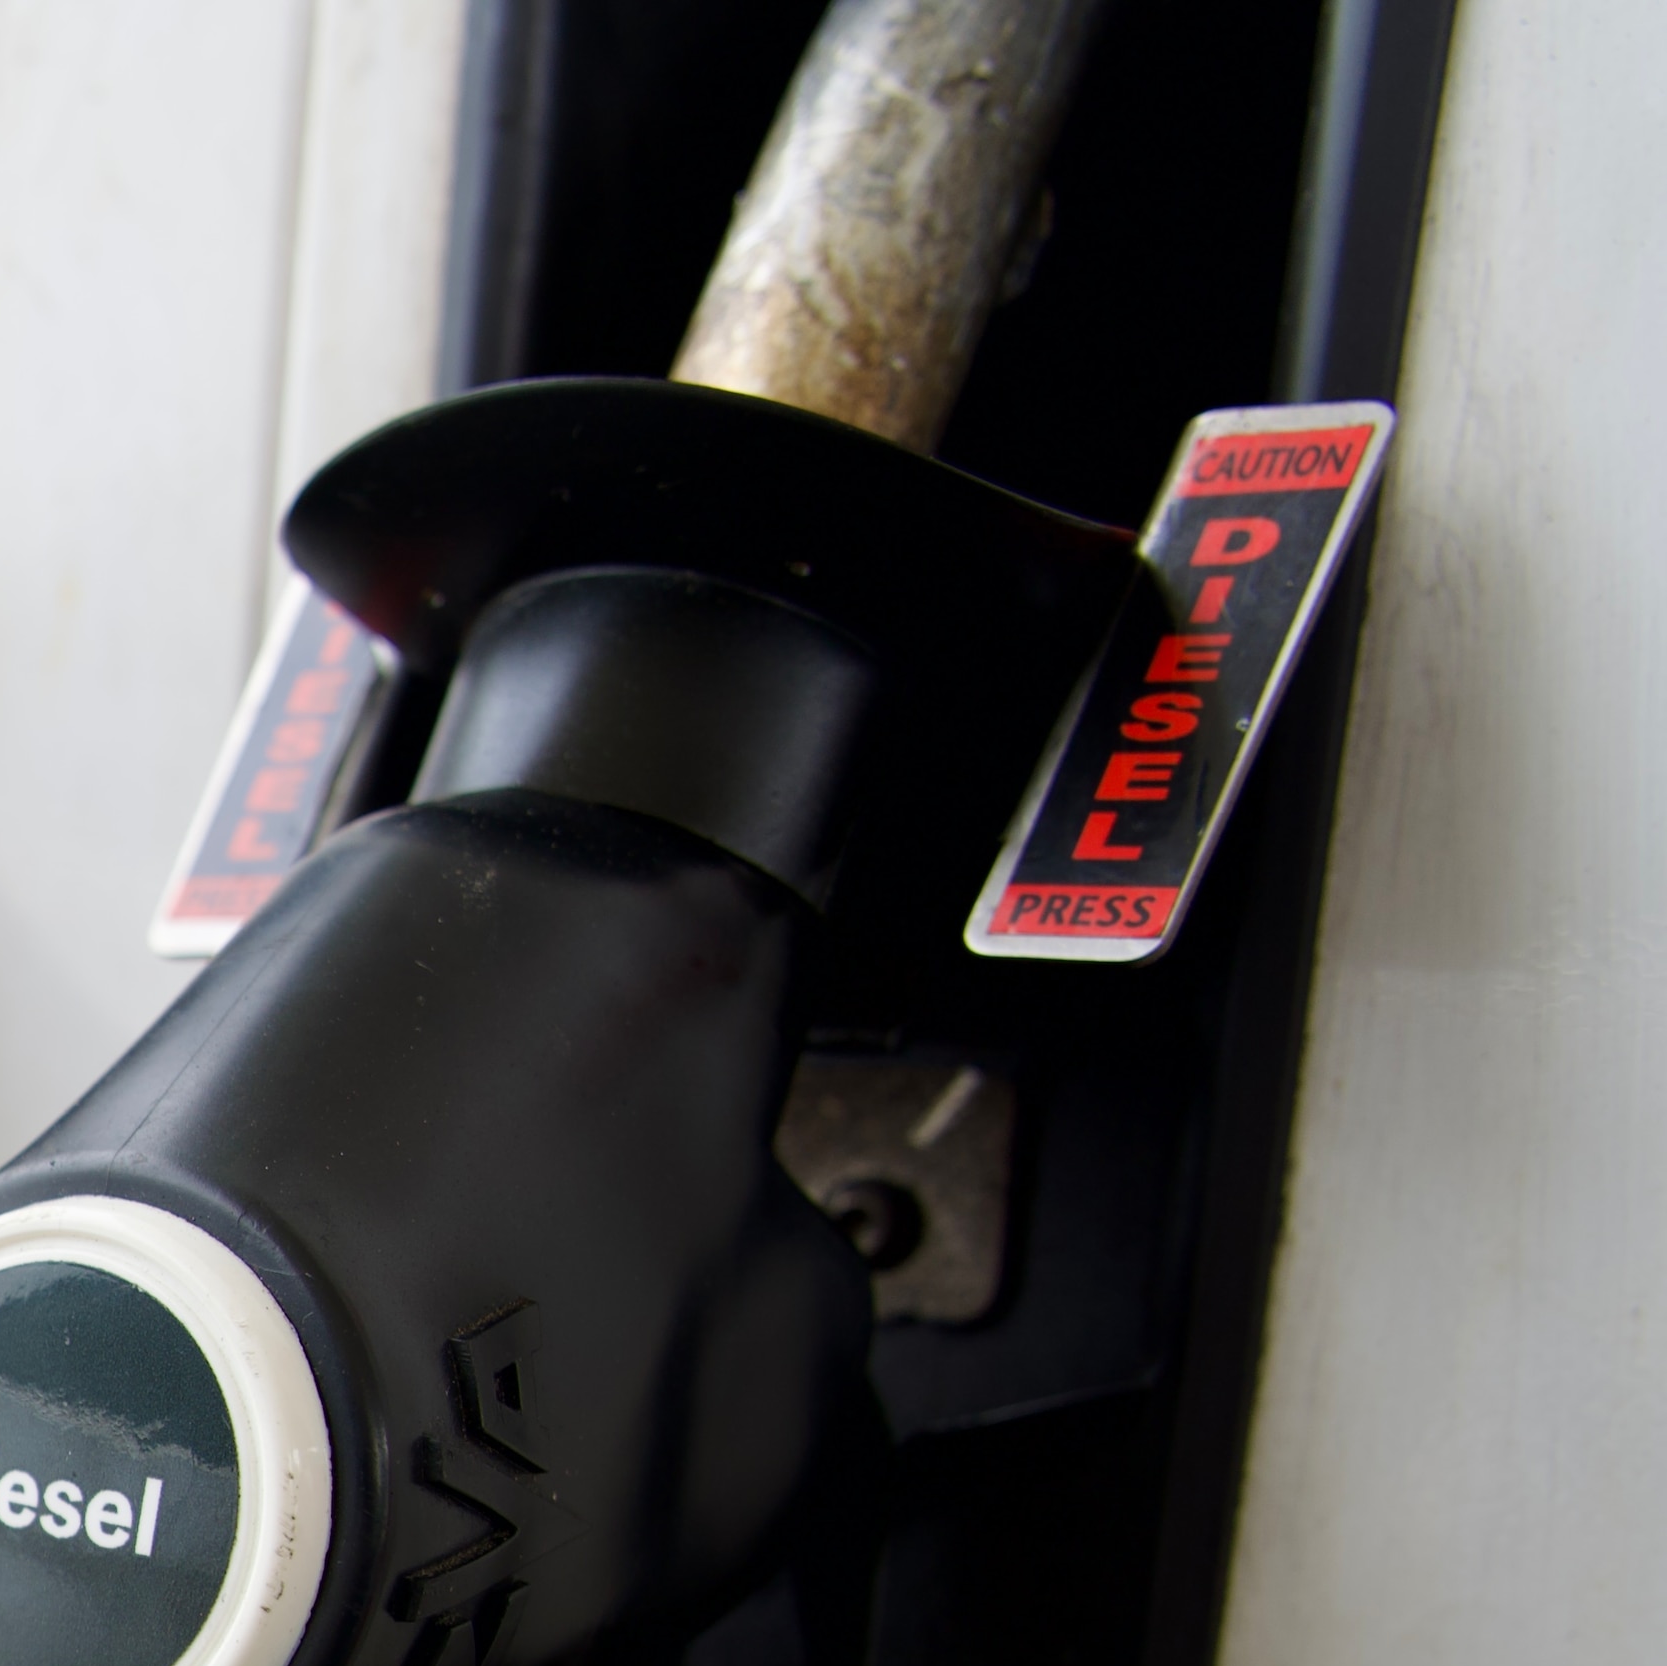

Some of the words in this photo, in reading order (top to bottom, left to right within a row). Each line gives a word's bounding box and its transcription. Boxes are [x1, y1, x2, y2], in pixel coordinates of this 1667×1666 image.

[1193, 442, 1354, 486] CAUTION
[226, 605, 354, 862] IESEL
[1072, 516, 1282, 861] DIESEL
[1007, 893, 1157, 930] PRESS
